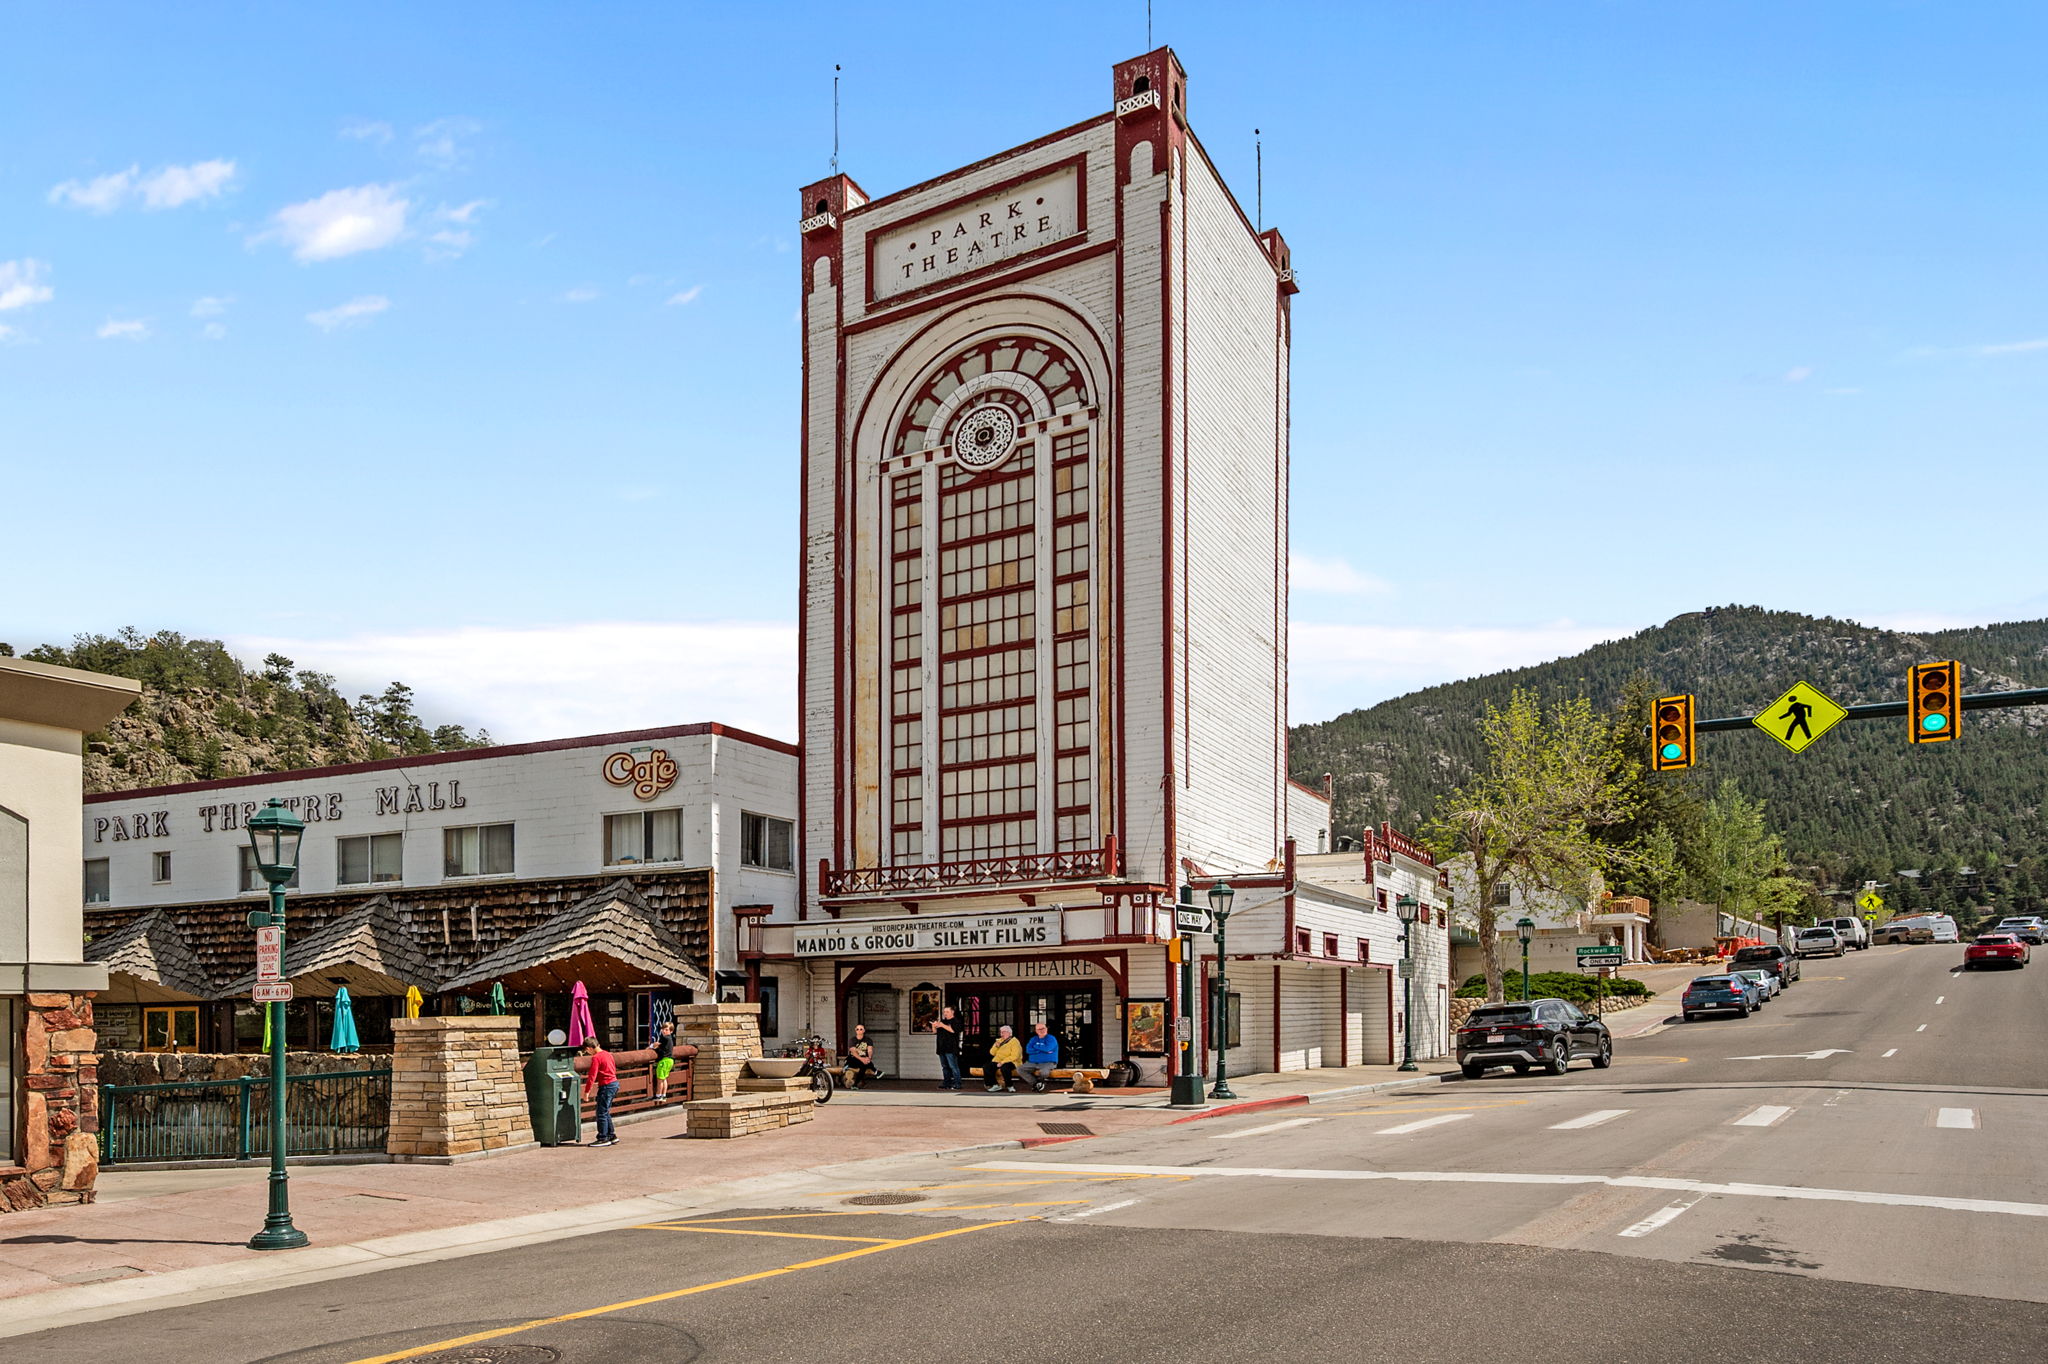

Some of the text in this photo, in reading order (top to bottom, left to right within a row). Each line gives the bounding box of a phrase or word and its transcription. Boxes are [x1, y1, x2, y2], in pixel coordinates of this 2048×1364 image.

[931, 201, 1022, 246] PARK
[902, 215, 1052, 278] THEATRE
[93, 811, 169, 843] PARK
[375, 780, 466, 816] MALL
[872, 921, 965, 933] HISTORICPARKTHEATRE.COM
[977, 918, 993, 927] LIVE
[996, 917, 1018, 927] PIANO
[1029, 915, 1045, 924] 7PM
[1179, 912, 1202, 925] ONE WAY
[264, 932, 273, 942] NO
[796, 926, 1046, 953] MANDO & GROGU SILENT FILMS
[259, 944, 279, 953] PARKING
[260, 955, 278, 963] LOADING
[954, 959, 1093, 978] PARK THEATRE
[256, 989, 261, 997] 6
[261, 988, 271, 997] AM
[275, 987, 280, 996] 6
[280, 987, 289, 996] PM
